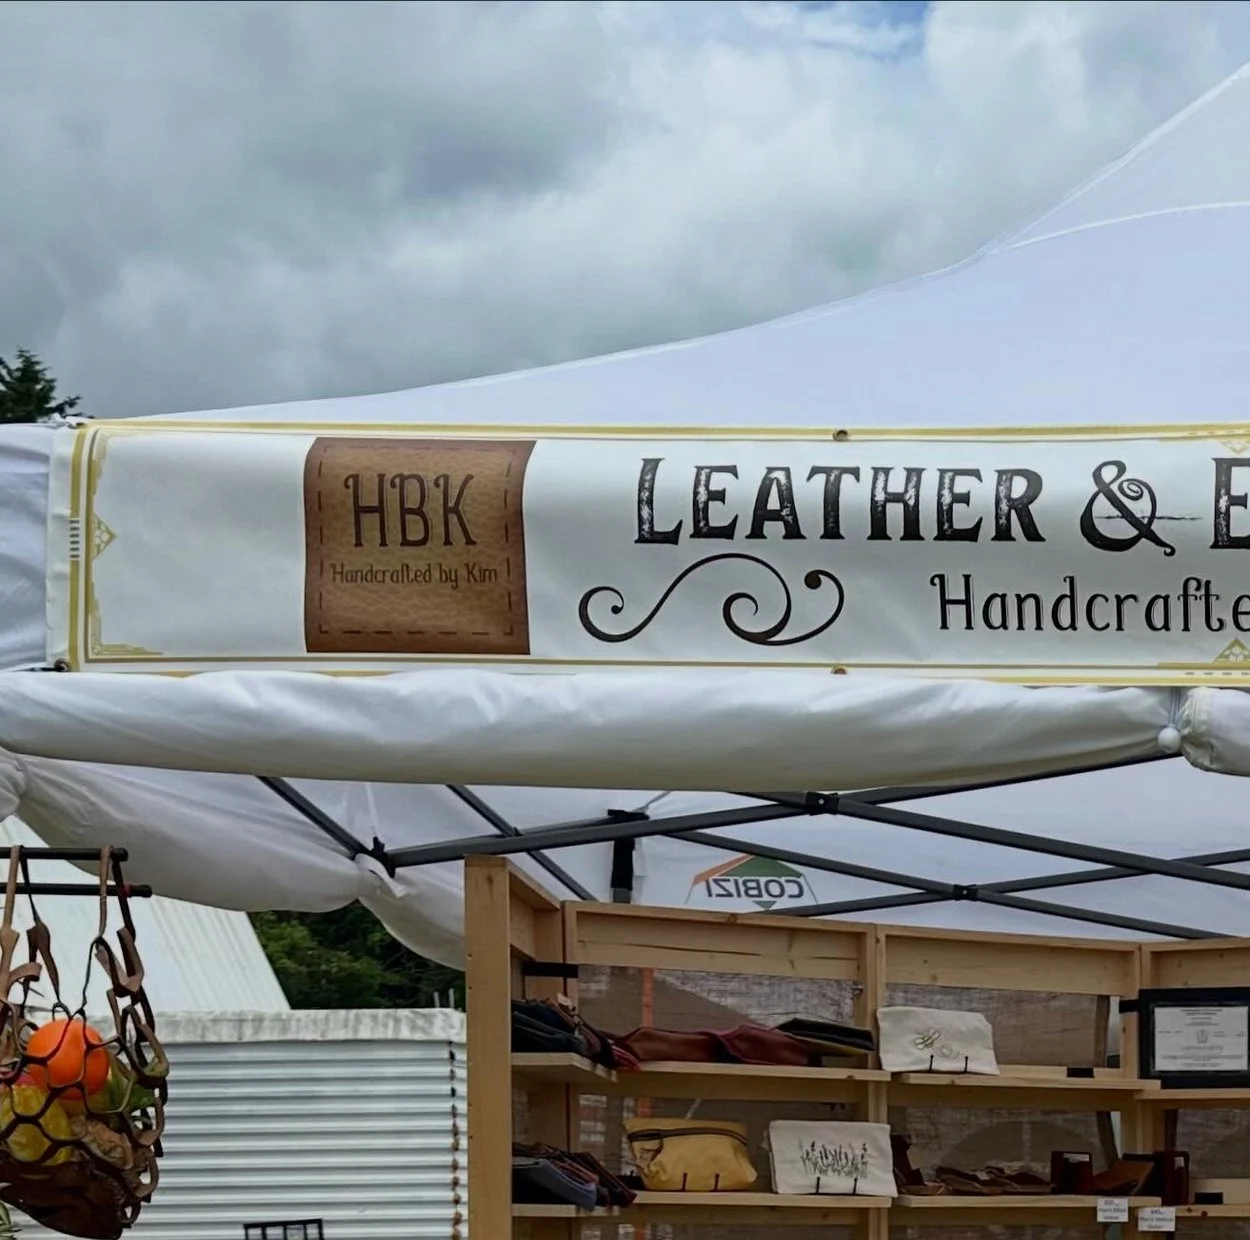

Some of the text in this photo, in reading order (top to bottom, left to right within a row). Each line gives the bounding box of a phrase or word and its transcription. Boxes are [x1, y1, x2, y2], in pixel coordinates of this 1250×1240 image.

[344, 473, 477, 547] HBK
[634, 457, 1046, 545] LEATHER
[1080, 460, 1178, 556] &
[330, 562, 498, 589] Handcrafted by Kim
